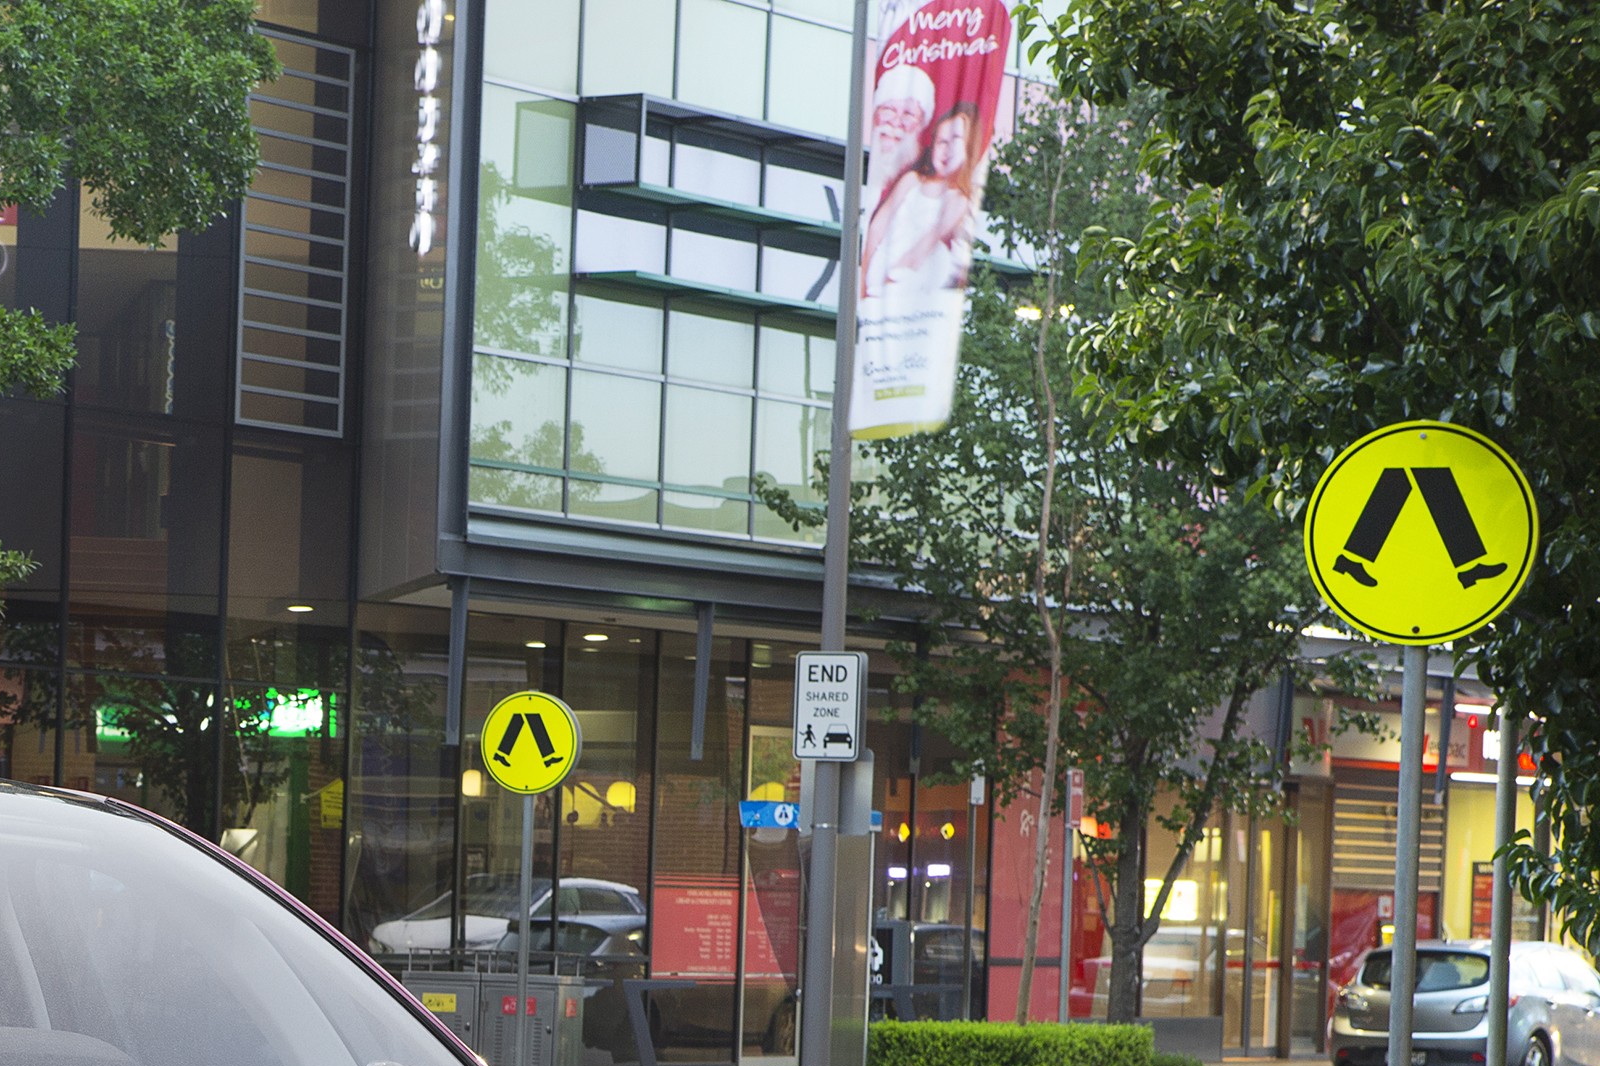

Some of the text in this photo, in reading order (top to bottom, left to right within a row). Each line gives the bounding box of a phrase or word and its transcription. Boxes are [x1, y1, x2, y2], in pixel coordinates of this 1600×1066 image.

[882, 34, 999, 68] Christmas
[808, 664, 847, 682] END
[806, 691, 849, 702] SHARED
[813, 707, 840, 717] ZONE
